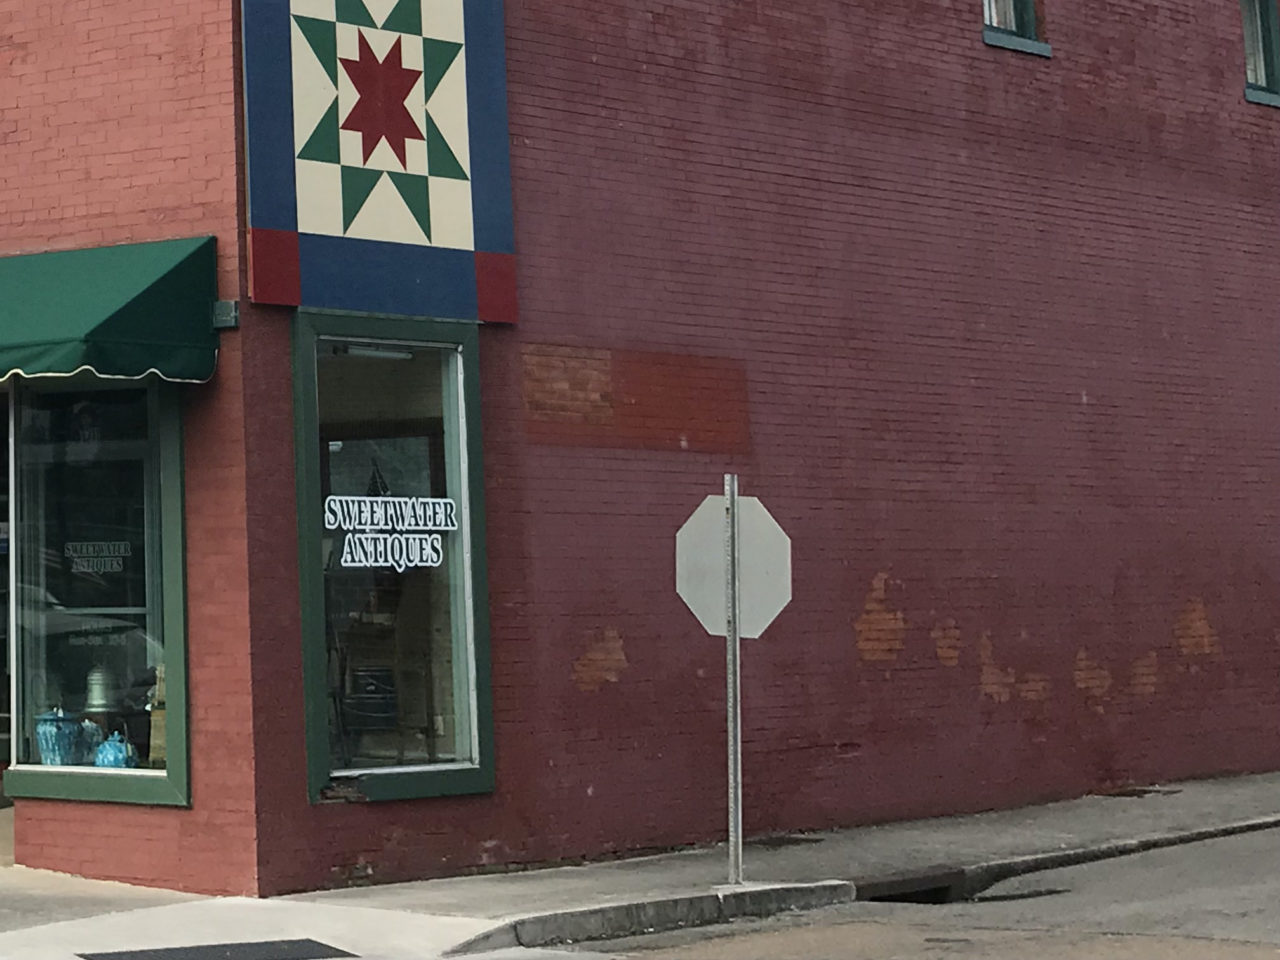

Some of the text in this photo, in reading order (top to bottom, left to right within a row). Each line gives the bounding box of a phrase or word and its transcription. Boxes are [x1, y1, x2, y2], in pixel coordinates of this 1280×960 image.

[325, 496, 457, 530] SWEETWATER
[65, 542, 131, 556] SWEETWATER
[341, 534, 443, 572] ANTIQUES
[72, 558, 123, 574] ANTIQUES
